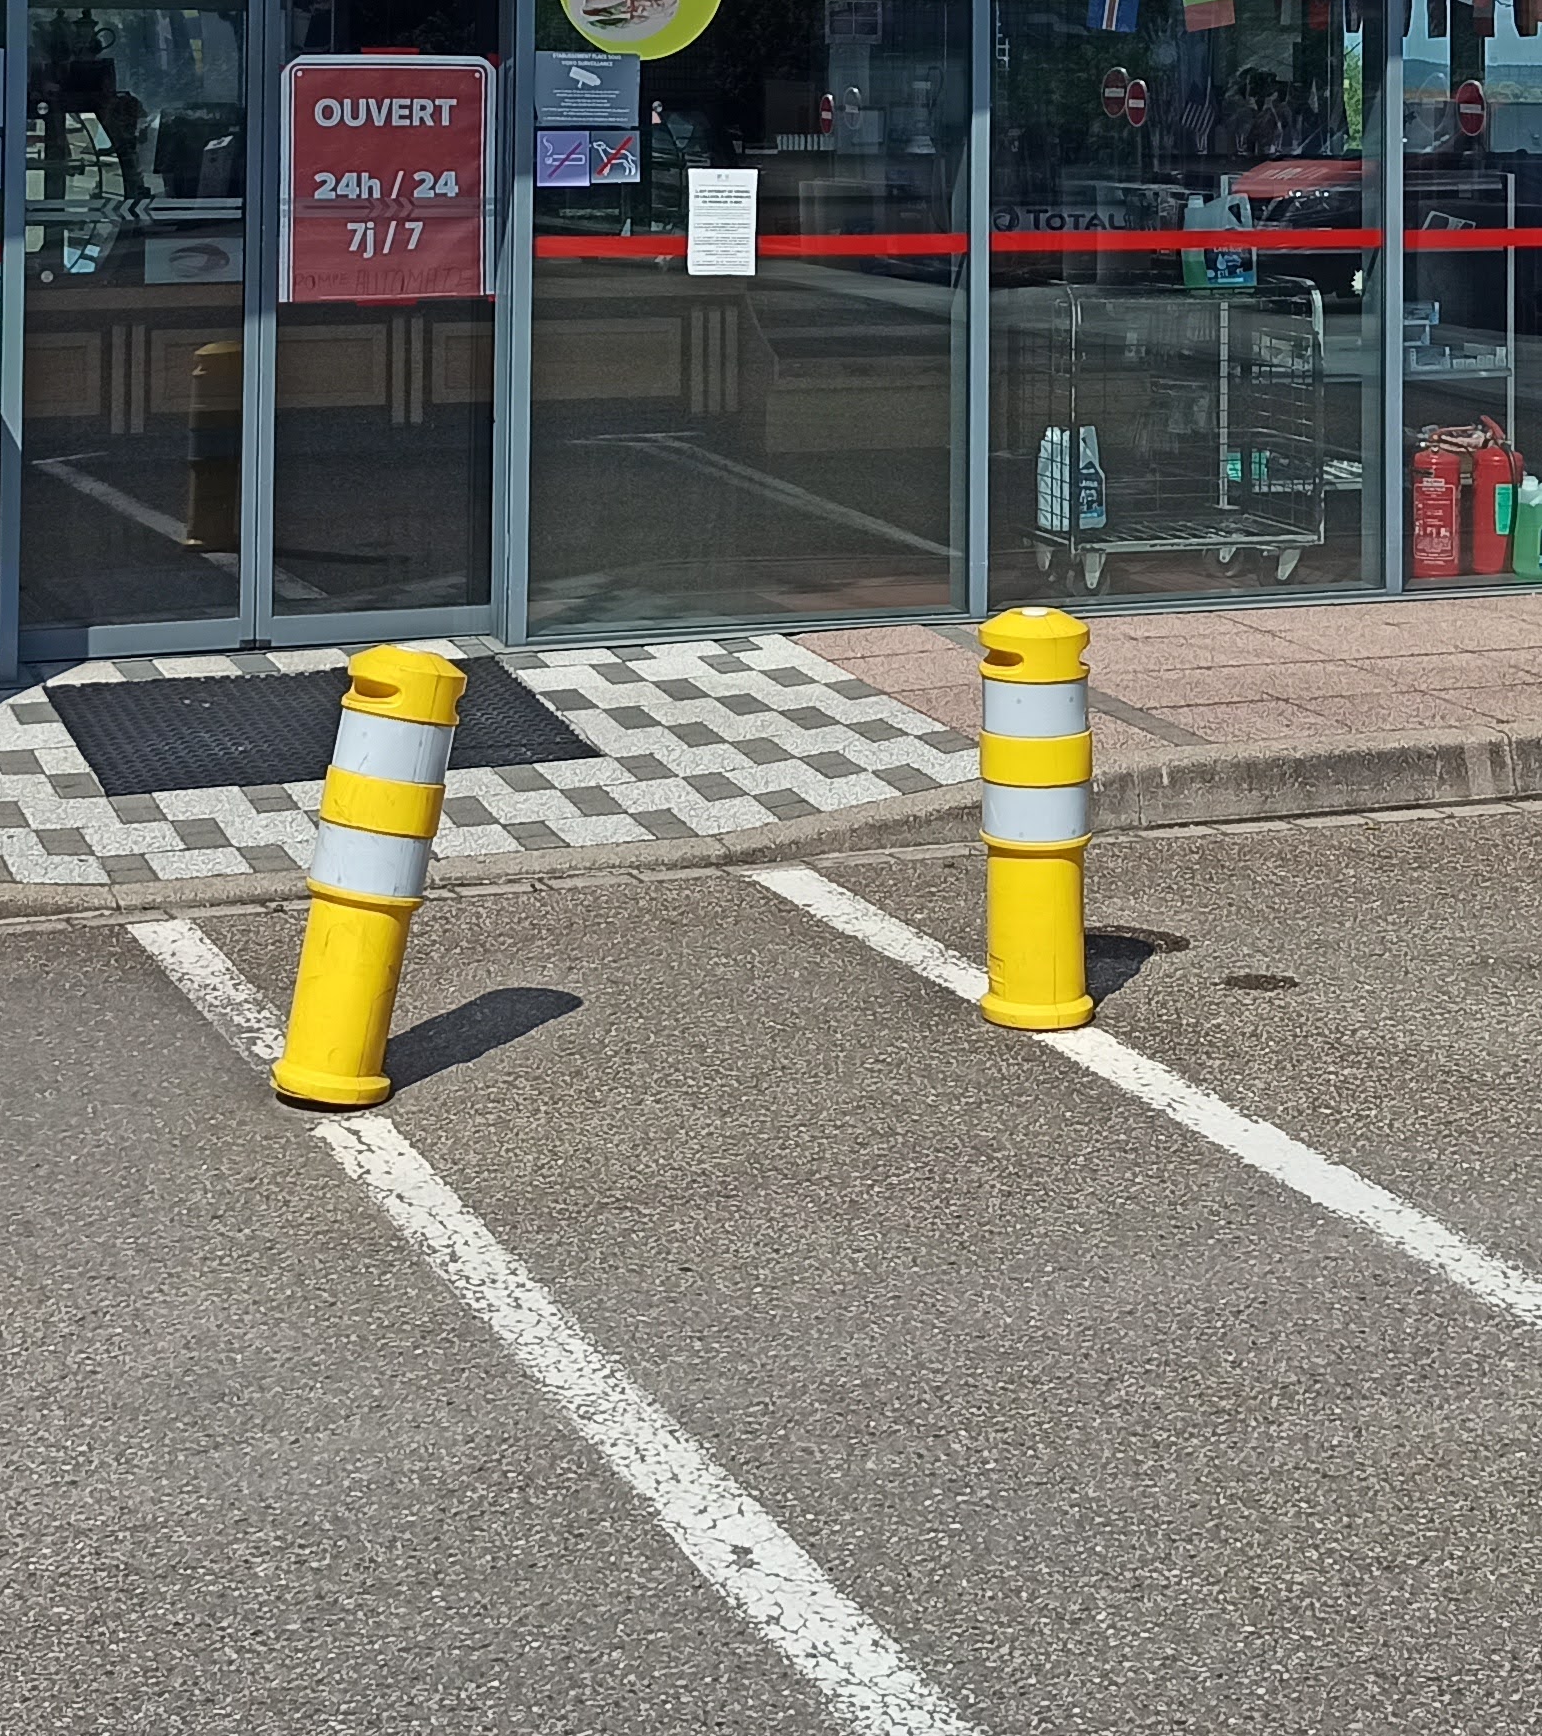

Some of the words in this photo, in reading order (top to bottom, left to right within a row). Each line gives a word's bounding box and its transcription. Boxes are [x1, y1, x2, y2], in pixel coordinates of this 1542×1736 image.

[313, 98, 458, 127] OUVERT
[313, 171, 381, 200] 24h
[390, 170, 405, 200] /
[412, 170, 459, 198] 24
[346, 220, 375, 259] 7j
[382, 220, 397, 254] /
[404, 220, 424, 250] 7
